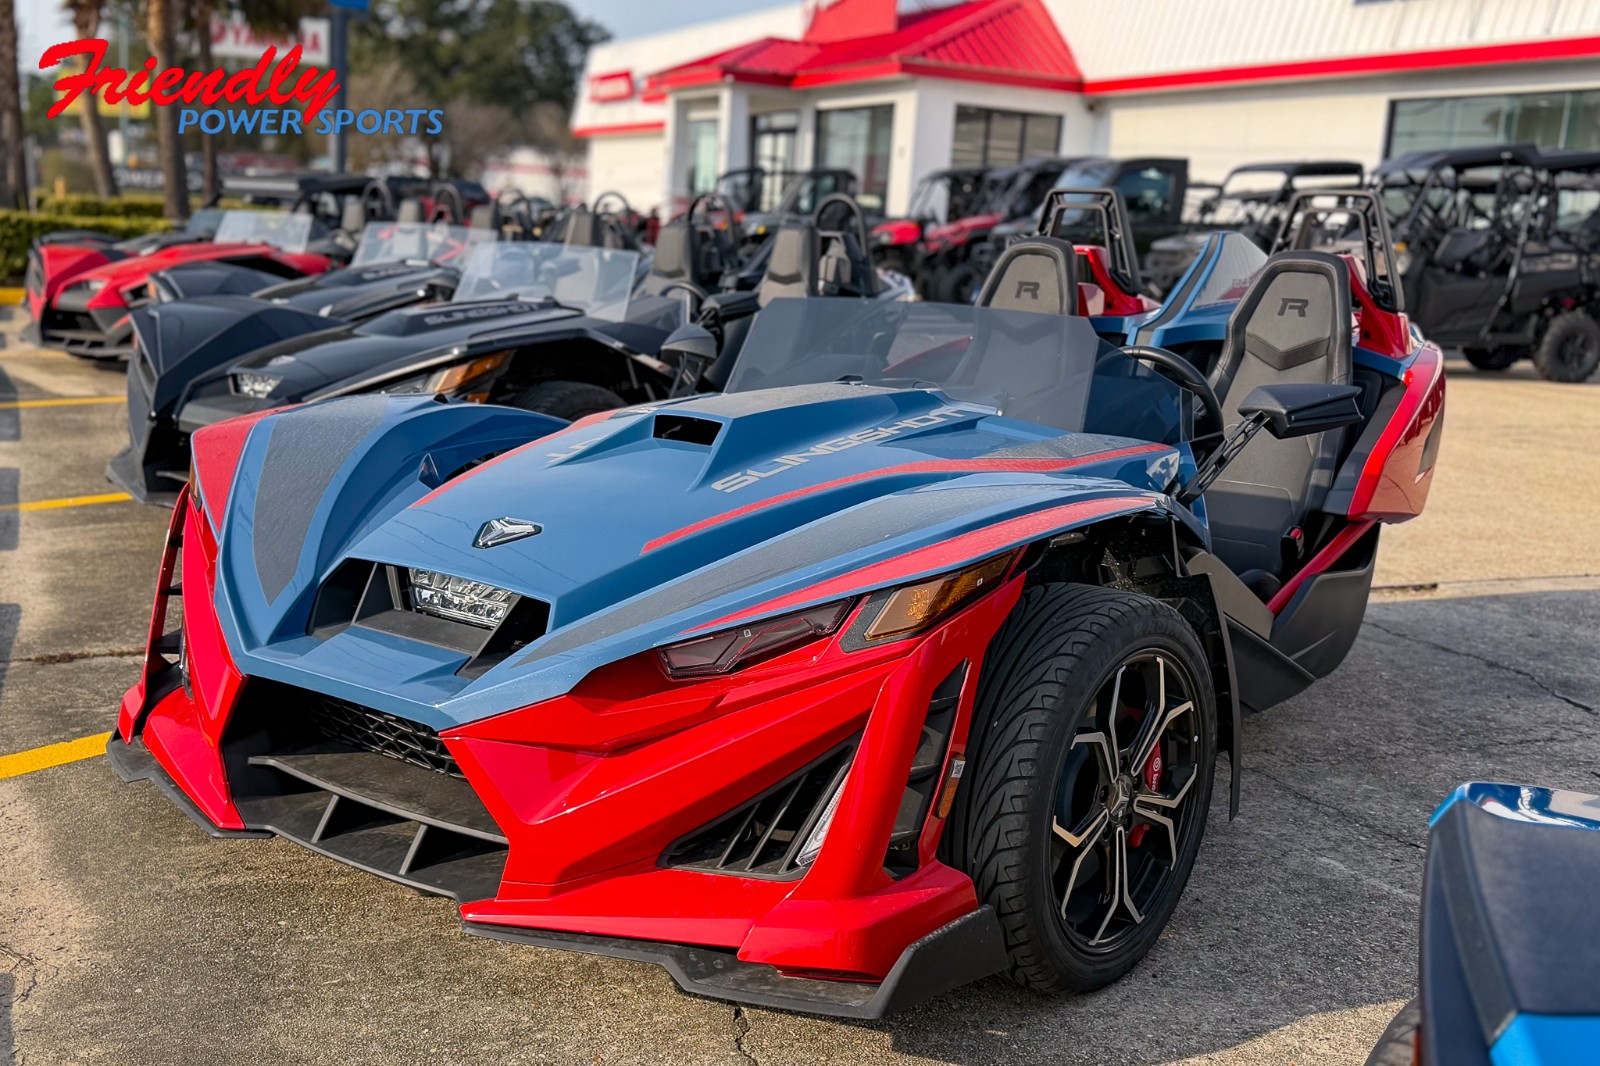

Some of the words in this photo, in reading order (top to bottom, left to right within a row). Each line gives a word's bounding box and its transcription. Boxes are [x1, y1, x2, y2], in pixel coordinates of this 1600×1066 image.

[1014, 280, 1041, 300] R
[1277, 297, 1309, 318] R
[711, 407, 967, 493] SLINGSHOT
